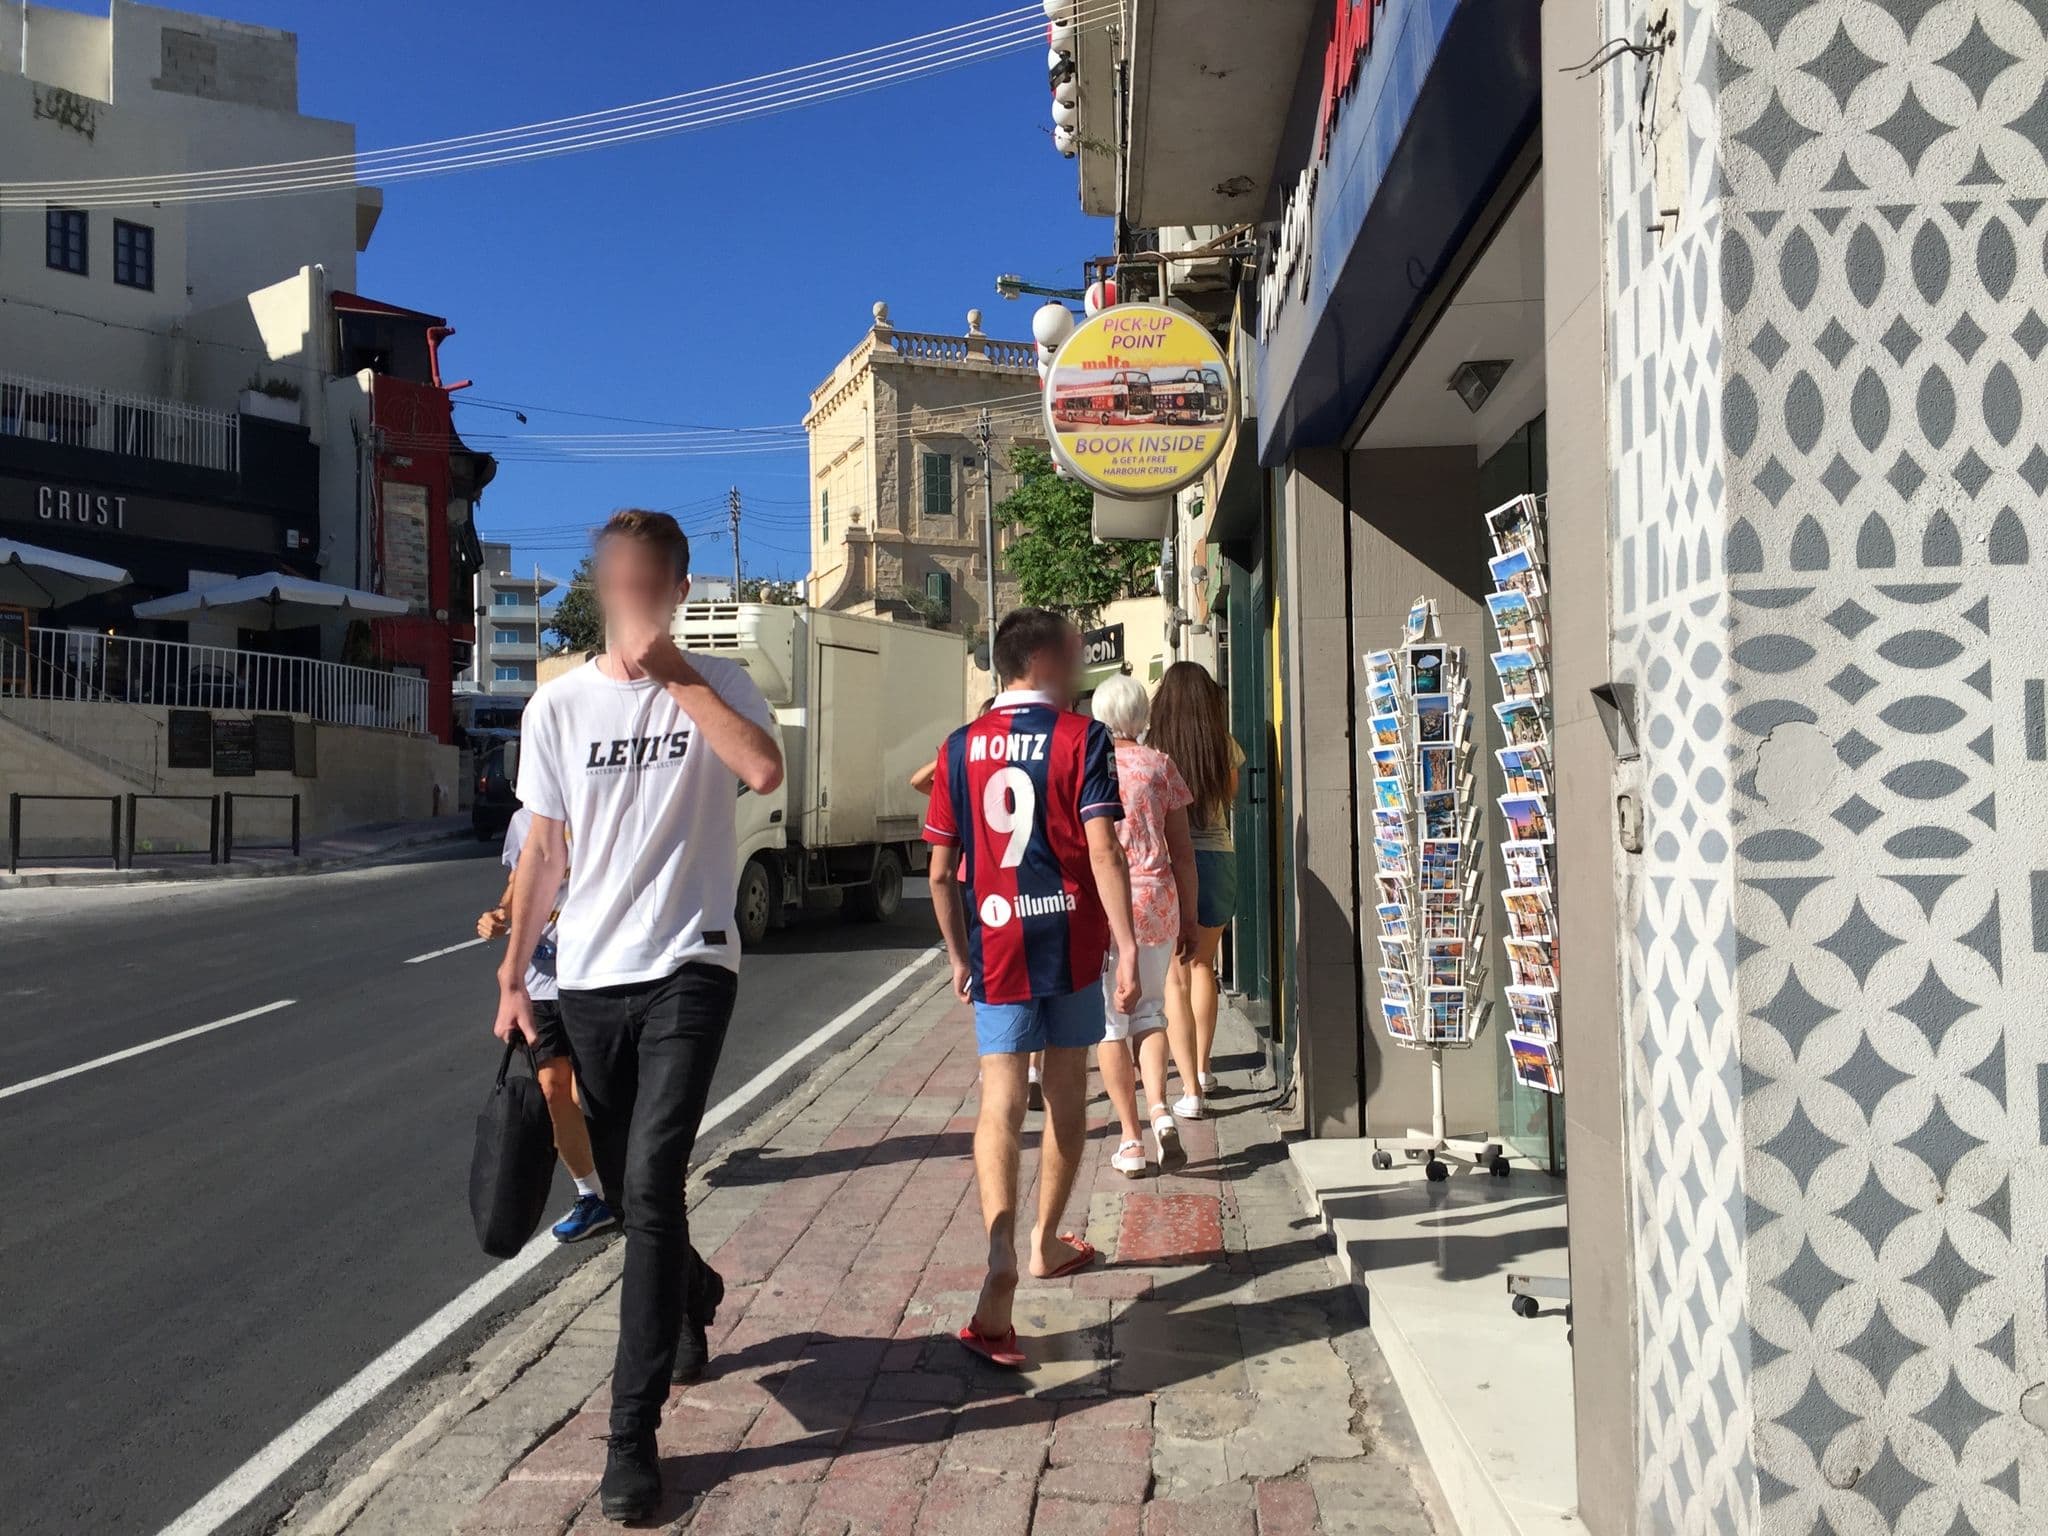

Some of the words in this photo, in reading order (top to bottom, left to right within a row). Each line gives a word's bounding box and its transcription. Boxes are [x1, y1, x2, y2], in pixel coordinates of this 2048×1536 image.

[1103, 316, 1173, 332] PICK-UP
[1111, 334, 1166, 349] POINT
[1082, 355, 1130, 370] malta
[1075, 437, 1134, 454] BOOK
[1139, 435, 1206, 452] INSIDE
[1120, 456, 1136, 464] GET
[1146, 455, 1167, 463] FREE
[1103, 467, 1146, 475] HARBOUR
[1147, 465, 1178, 474] CRUISE
[39, 486, 127, 529] CRUST
[586, 731, 690, 768] LEVI'S
[969, 733, 1048, 762] MONTZ
[983, 766, 1036, 869] 9
[1013, 889, 1077, 918] illumia
